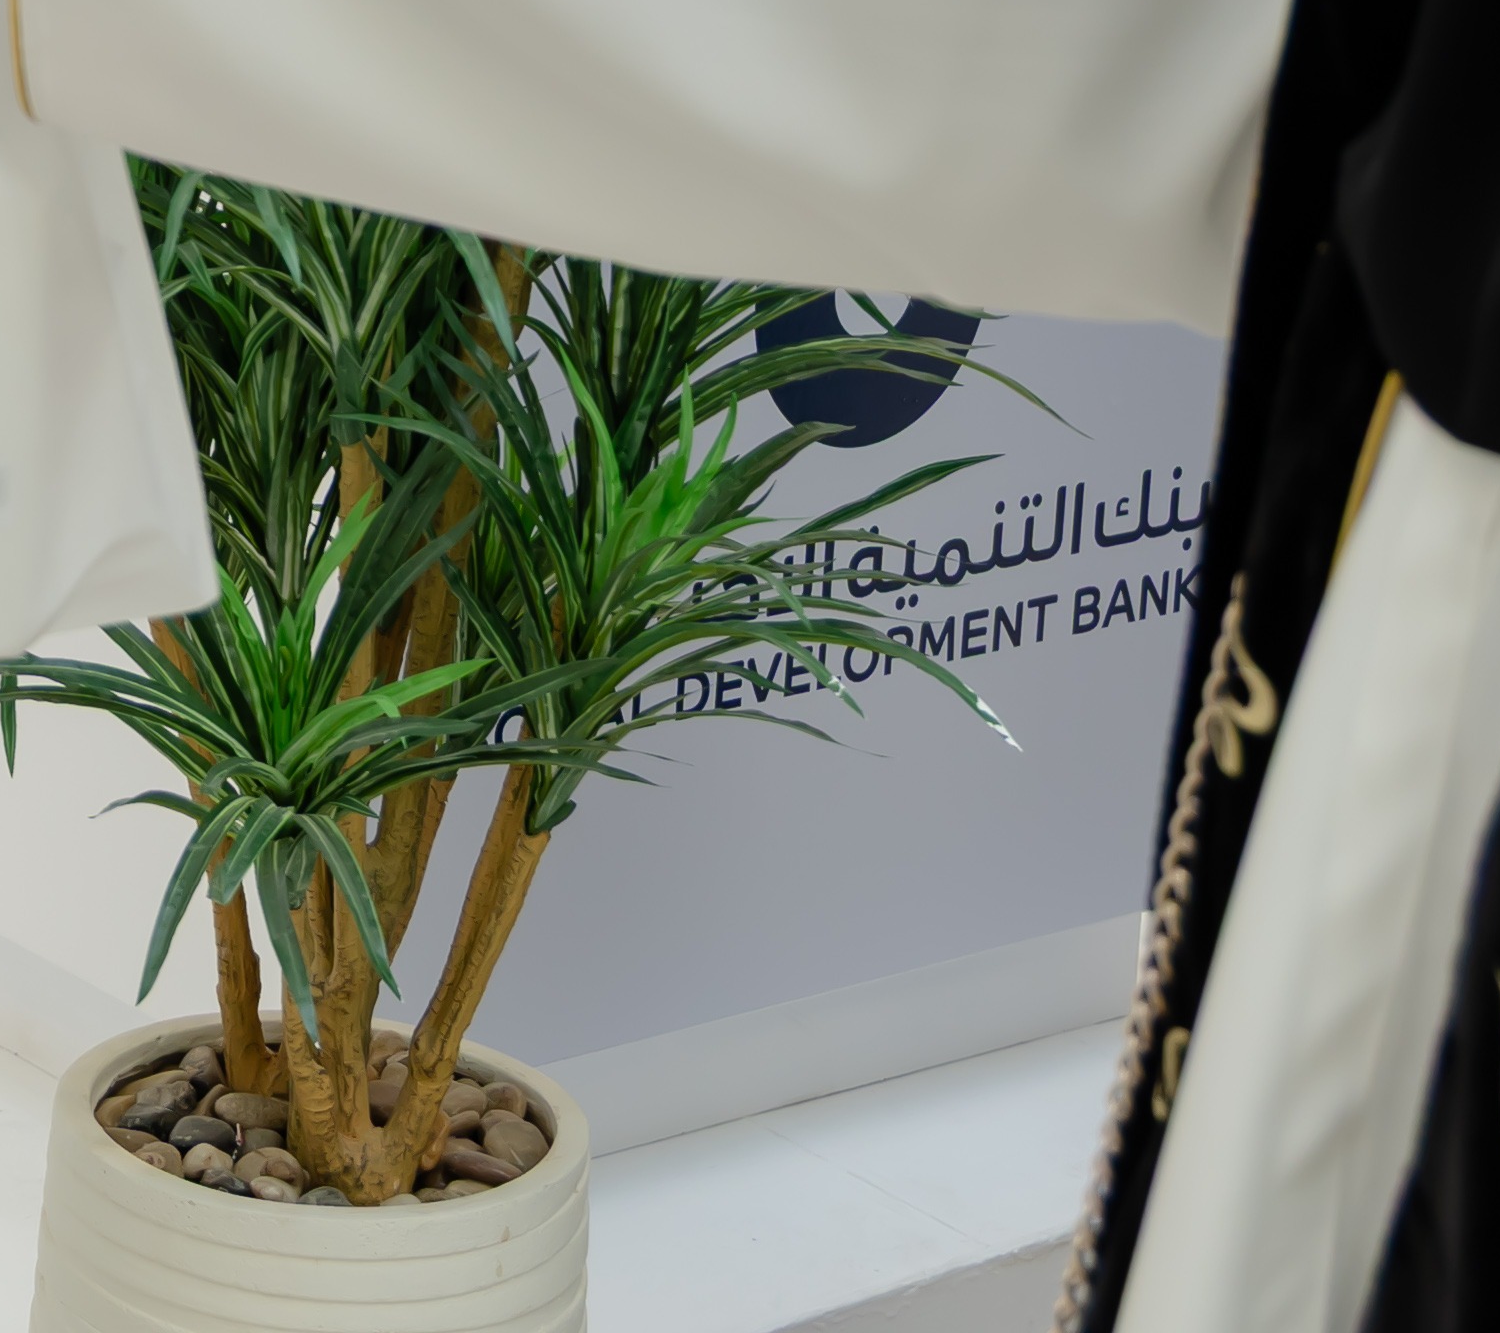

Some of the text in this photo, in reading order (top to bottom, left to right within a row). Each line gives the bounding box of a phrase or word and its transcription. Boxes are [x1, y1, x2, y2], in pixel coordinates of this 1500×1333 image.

[846, 482, 1085, 611] التنمية
[1095, 466, 1211, 551] بنك
[1071, 563, 1201, 635] BANK
